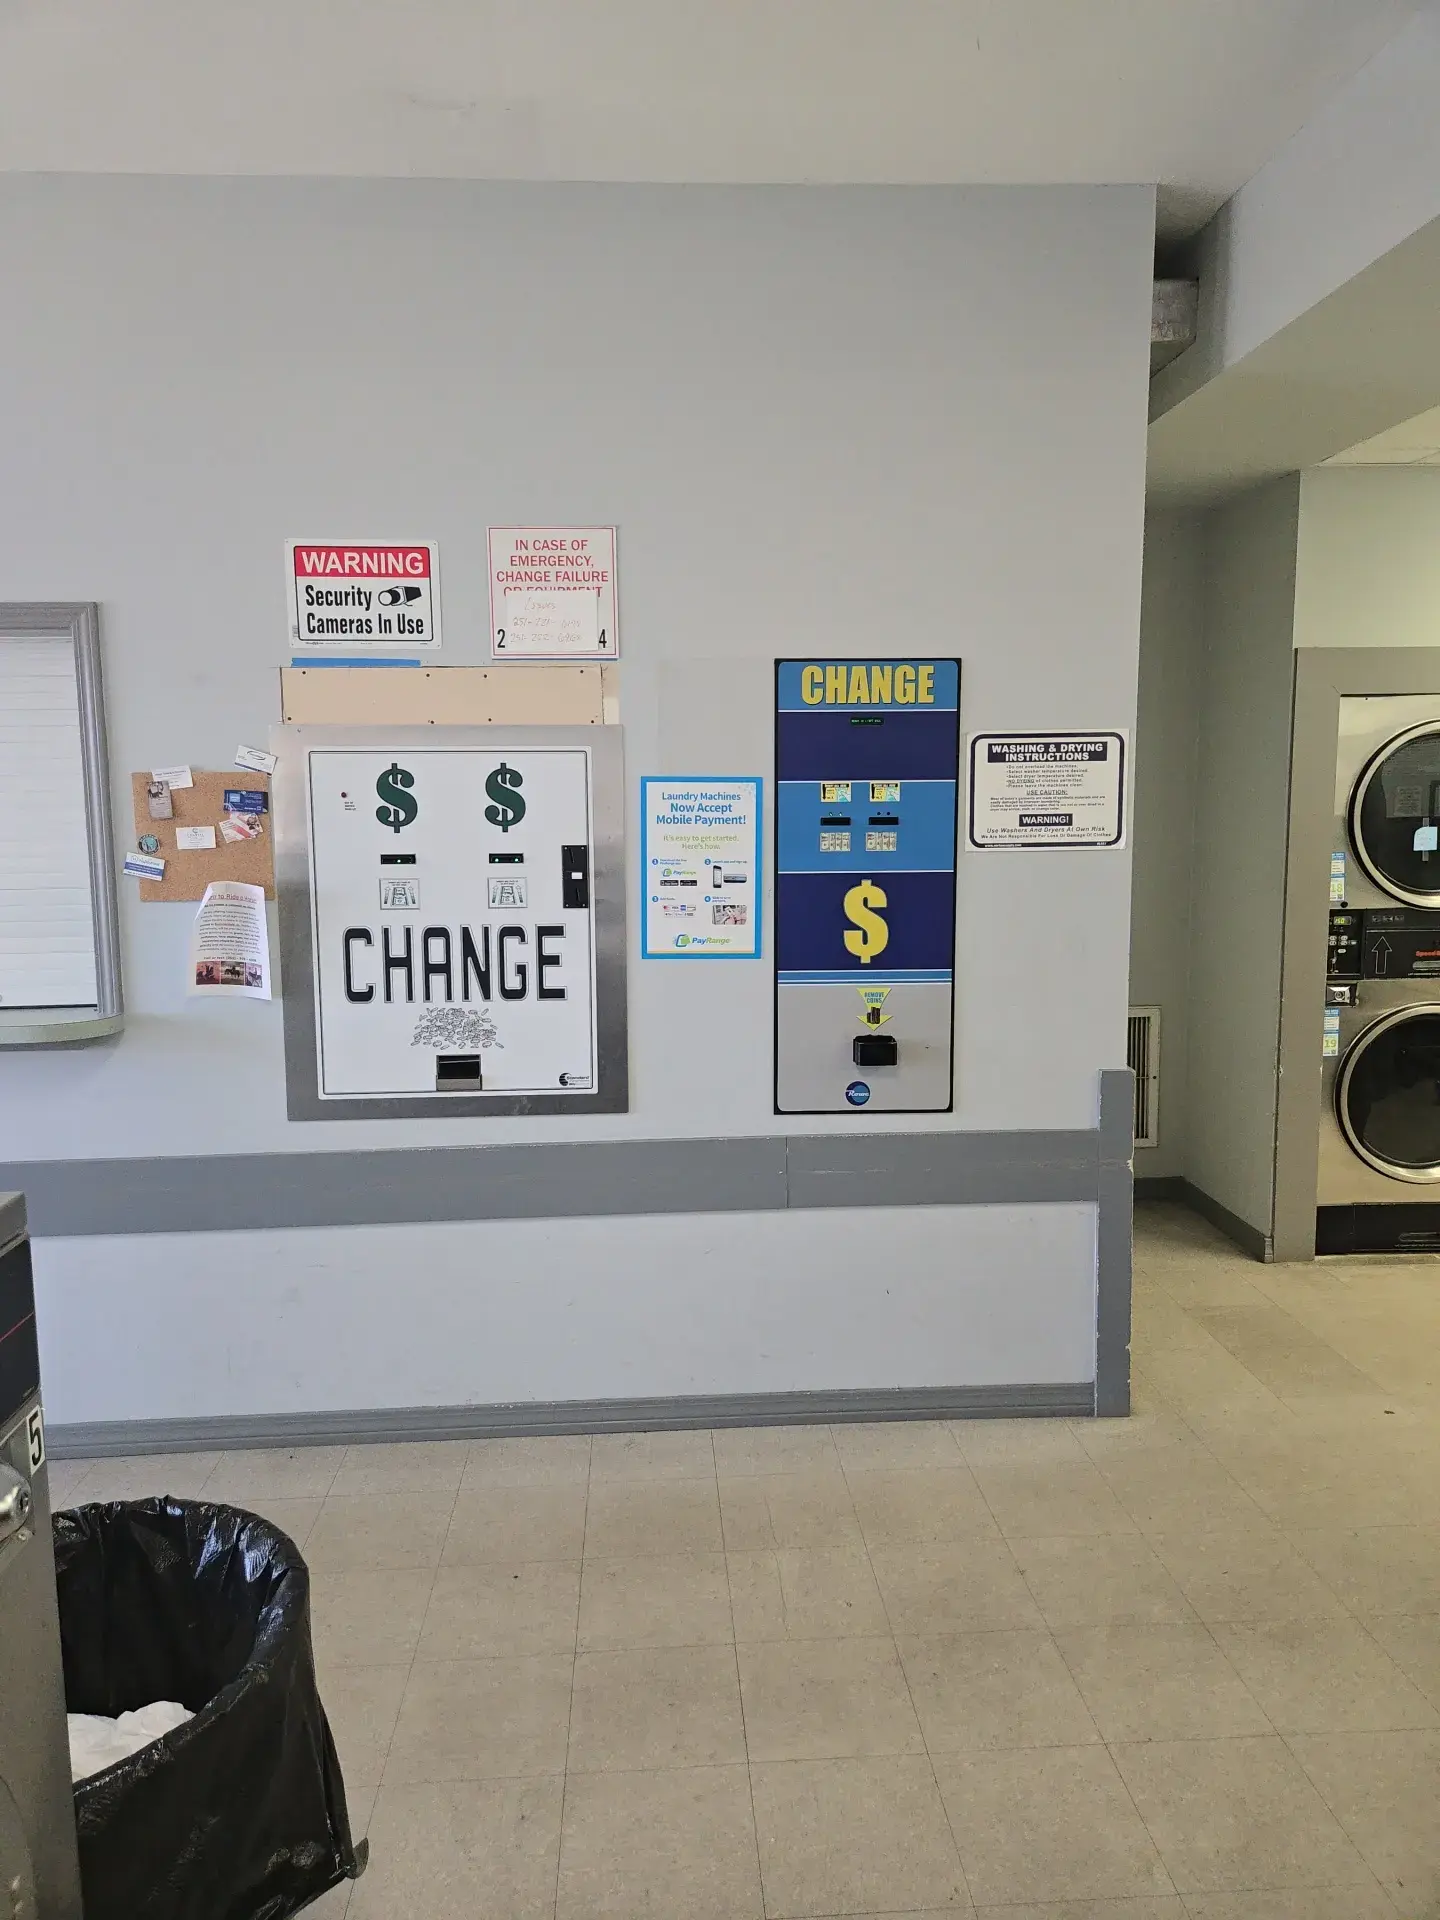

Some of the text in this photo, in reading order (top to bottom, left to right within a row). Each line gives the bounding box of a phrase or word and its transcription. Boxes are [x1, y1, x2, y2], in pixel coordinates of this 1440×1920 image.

[515, 539, 588, 551] IN CASE OF
[301, 551, 424, 575] WARNING
[510, 555, 594, 568] EMERGENCY,
[496, 571, 609, 582] CHANGE FAILURE
[305, 585, 372, 611] Security
[306, 613, 424, 635] Cameras In Use
[497, 628, 506, 649] 2
[598, 628, 607, 649] 4
[802, 665, 936, 706] CHANGE
[991, 743, 1103, 753] WASHING & DRYING
[1005, 752, 1090, 762] INSTRUCTIONS
[662, 792, 741, 802] Laundry Machines
[670, 802, 733, 815] Now Accept
[656, 814, 746, 827] Mobile Payment!
[1022, 815, 1070, 824] WARNING!
[1044, 826, 1065, 834] Dryers
[676, 836, 691, 844] easy
[701, 836, 712, 844] get
[1330, 883, 1343, 893] 18
[692, 937, 730, 946] PayRange
[342, 923, 568, 1004] CHANGE
[1324, 1038, 1337, 1048] 19
[28, 1411, 42, 1463] 5
